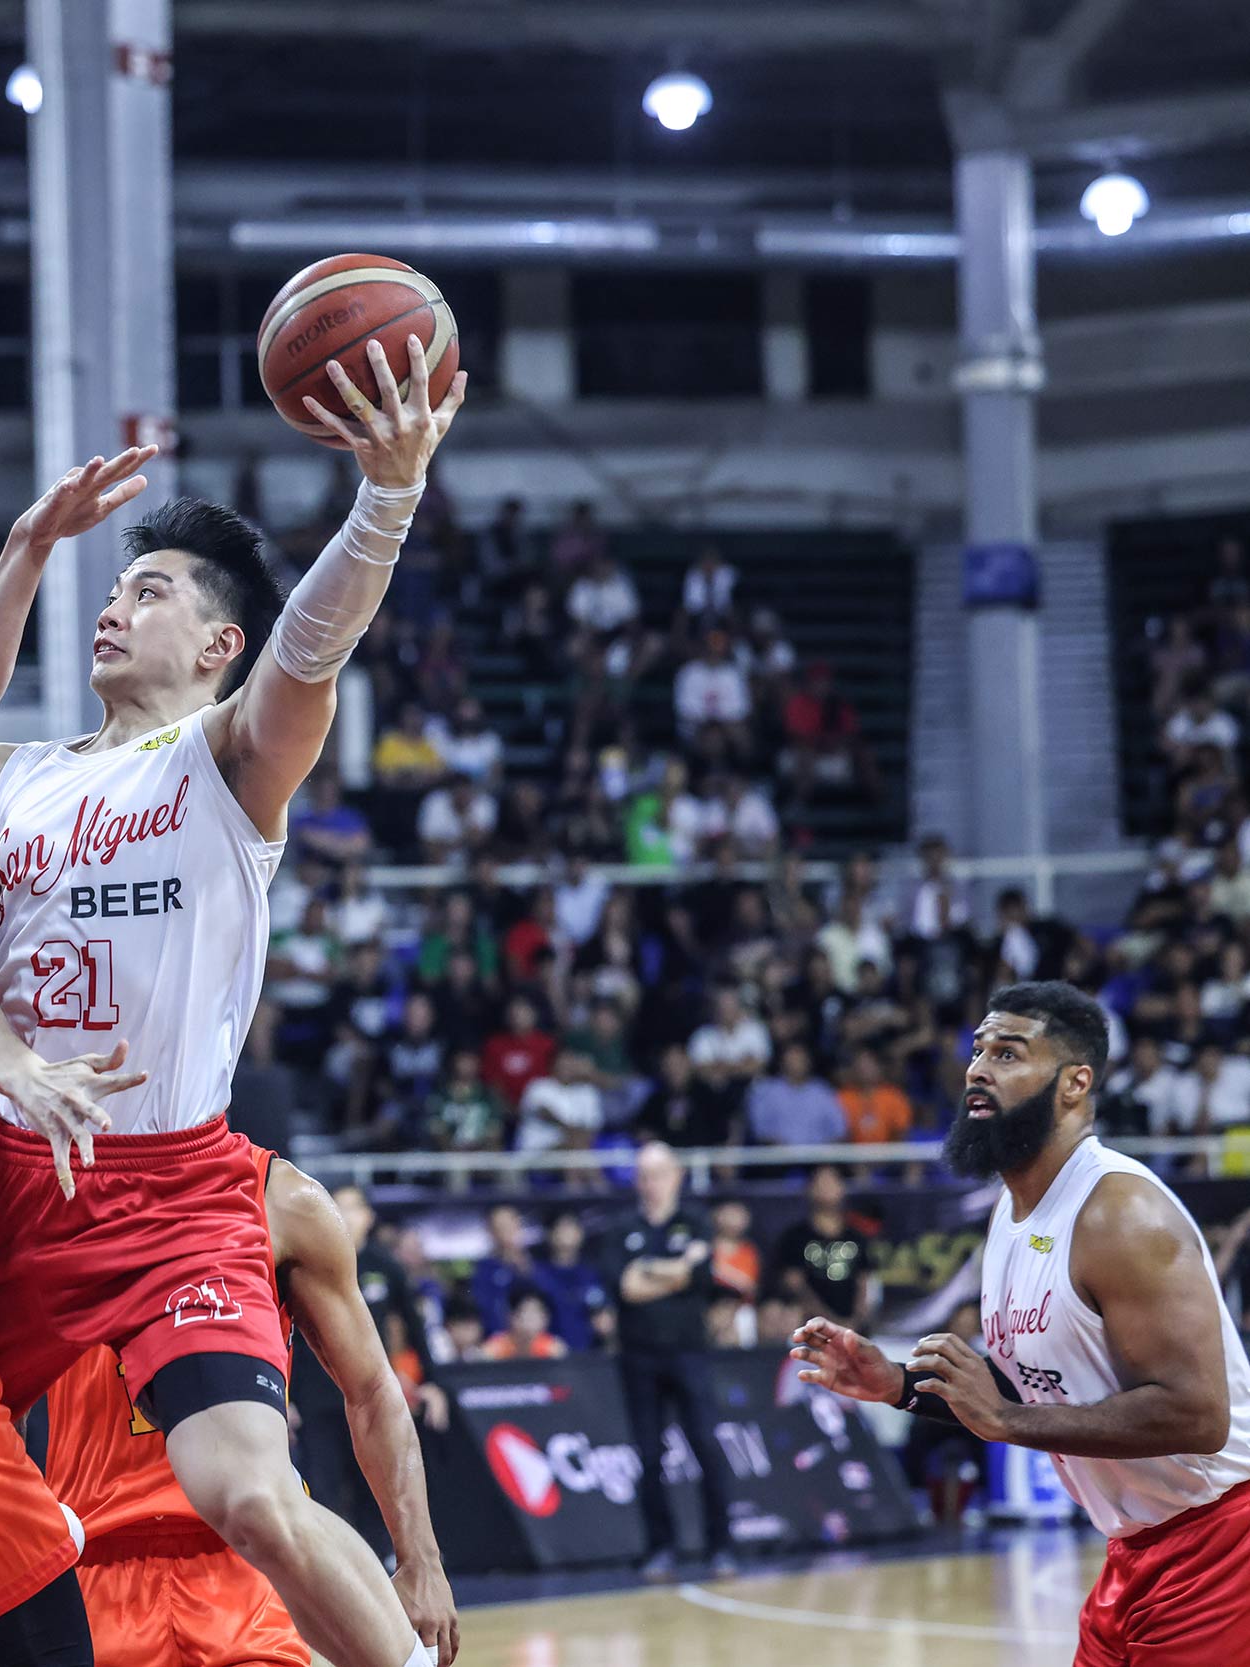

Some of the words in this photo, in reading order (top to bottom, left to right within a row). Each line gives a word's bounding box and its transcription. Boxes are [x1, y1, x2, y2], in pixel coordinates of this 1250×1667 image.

[287, 299, 365, 356] molten
[31, 775, 189, 896] Miguel
[70, 877, 184, 919] BEER
[30, 939, 120, 1031] 21
[164, 1276, 243, 1329] 21
